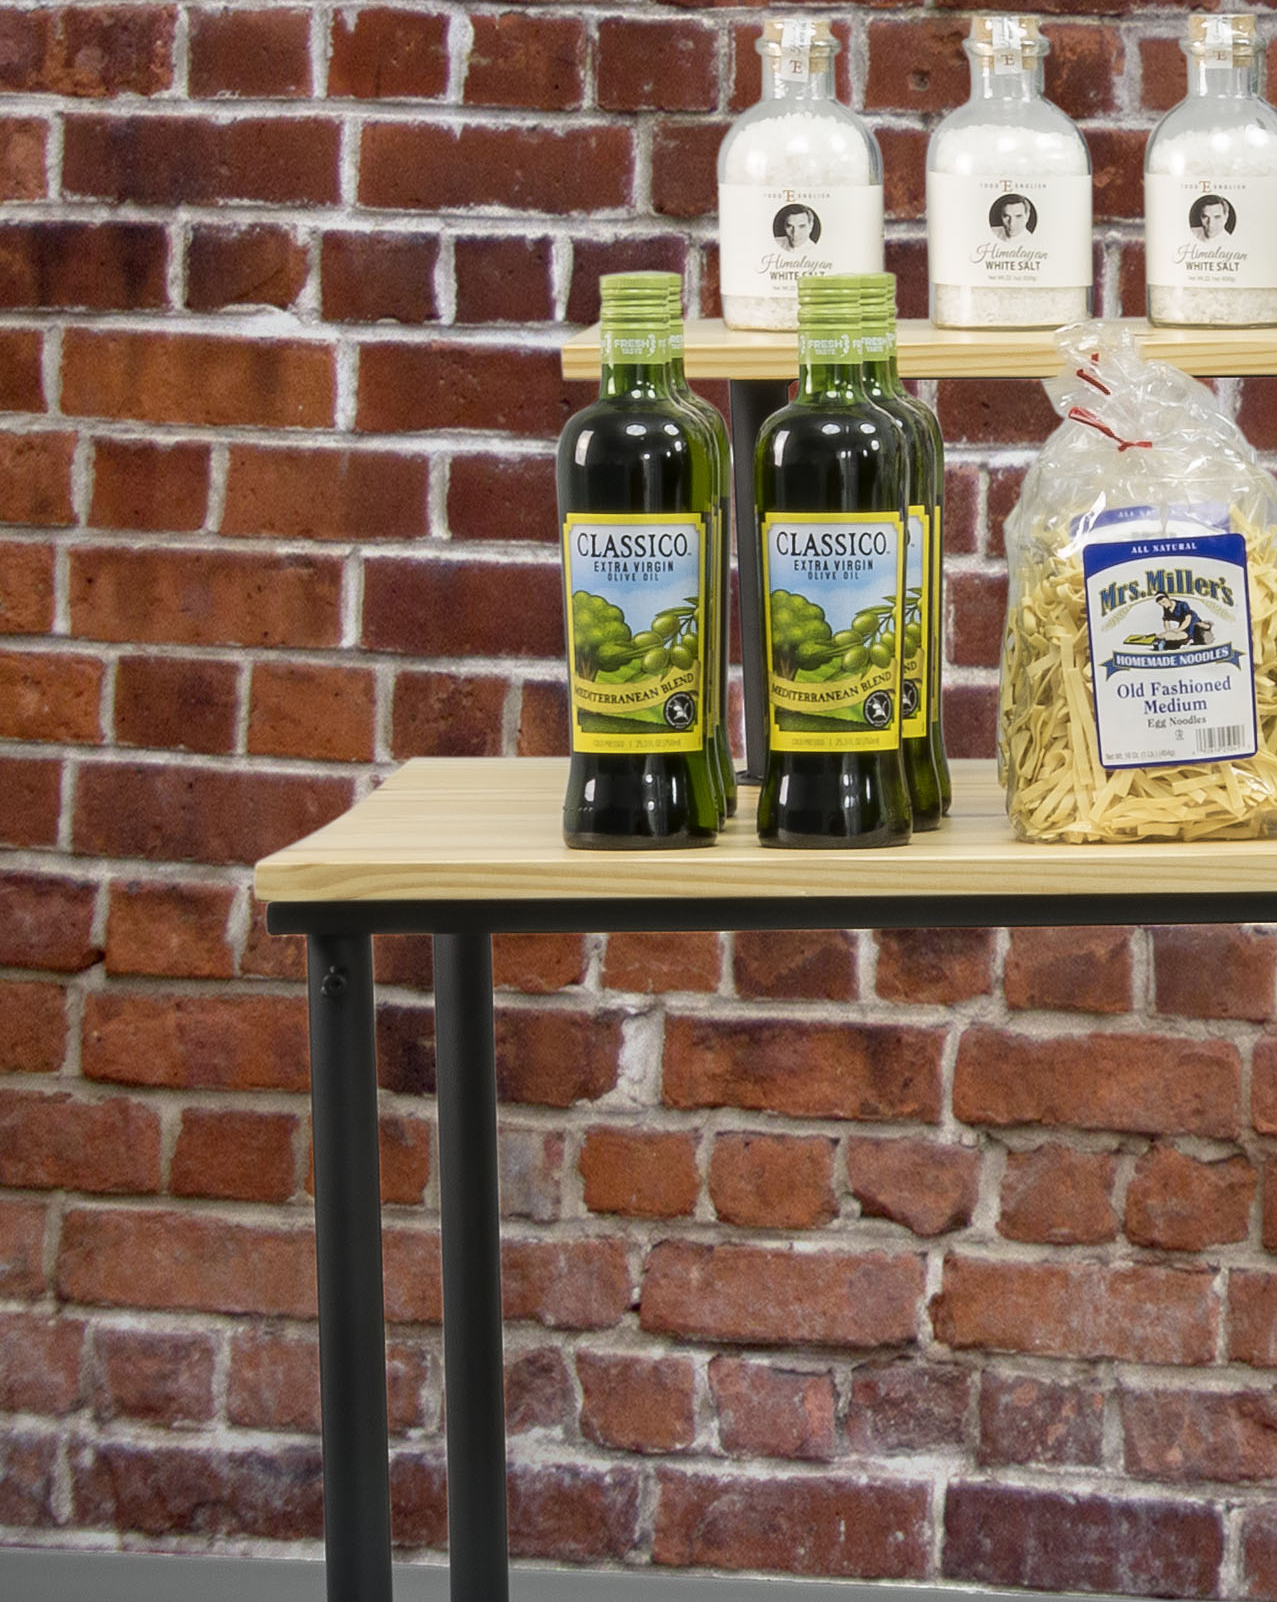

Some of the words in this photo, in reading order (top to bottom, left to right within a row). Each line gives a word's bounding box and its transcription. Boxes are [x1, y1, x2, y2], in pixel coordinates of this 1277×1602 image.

[969, 242, 1049, 264] Himalayan
[1173, 242, 1248, 265] Himalayan
[756, 253, 833, 274] Himalayan
[985, 260, 1016, 271] WHITE
[1018, 260, 1041, 271] SALT
[1185, 261, 1214, 272] WHITE
[1217, 261, 1240, 272] SALT
[769, 271, 800, 281] WHITE
[577, 532, 689, 558] CLASSICO
[776, 531, 887, 557] CLASSICO
[1131, 545, 1150, 554] ALL
[1153, 542, 1198, 553] NATURAL
[594, 560, 629, 573] EXTRA
[634, 560, 674, 573] VIRGIN
[794, 559, 829, 572] EXTRA
[834, 559, 874, 571] VIRGIN
[607, 572, 637, 582] OLIVE
[643, 572, 660, 582] OIL
[807, 571, 838, 580] OLIVE
[843, 571, 860, 580] OIL
[1116, 653, 1178, 668] HOMEMADE
[1179, 648, 1230, 666] NOODLES
[574, 682, 660, 705] MEDITERRANEAN
[662, 672, 694, 694] BLEND
[771, 682, 860, 704] MEDITERRANEAN
[861, 671, 892, 692] BLEND
[1117, 683, 1145, 699] Old
[1150, 675, 1232, 697] Fashioned
[1144, 698, 1208, 715] Medium
[1147, 718, 1167, 729] Egg
[1169, 715, 1208, 726] Noodles
